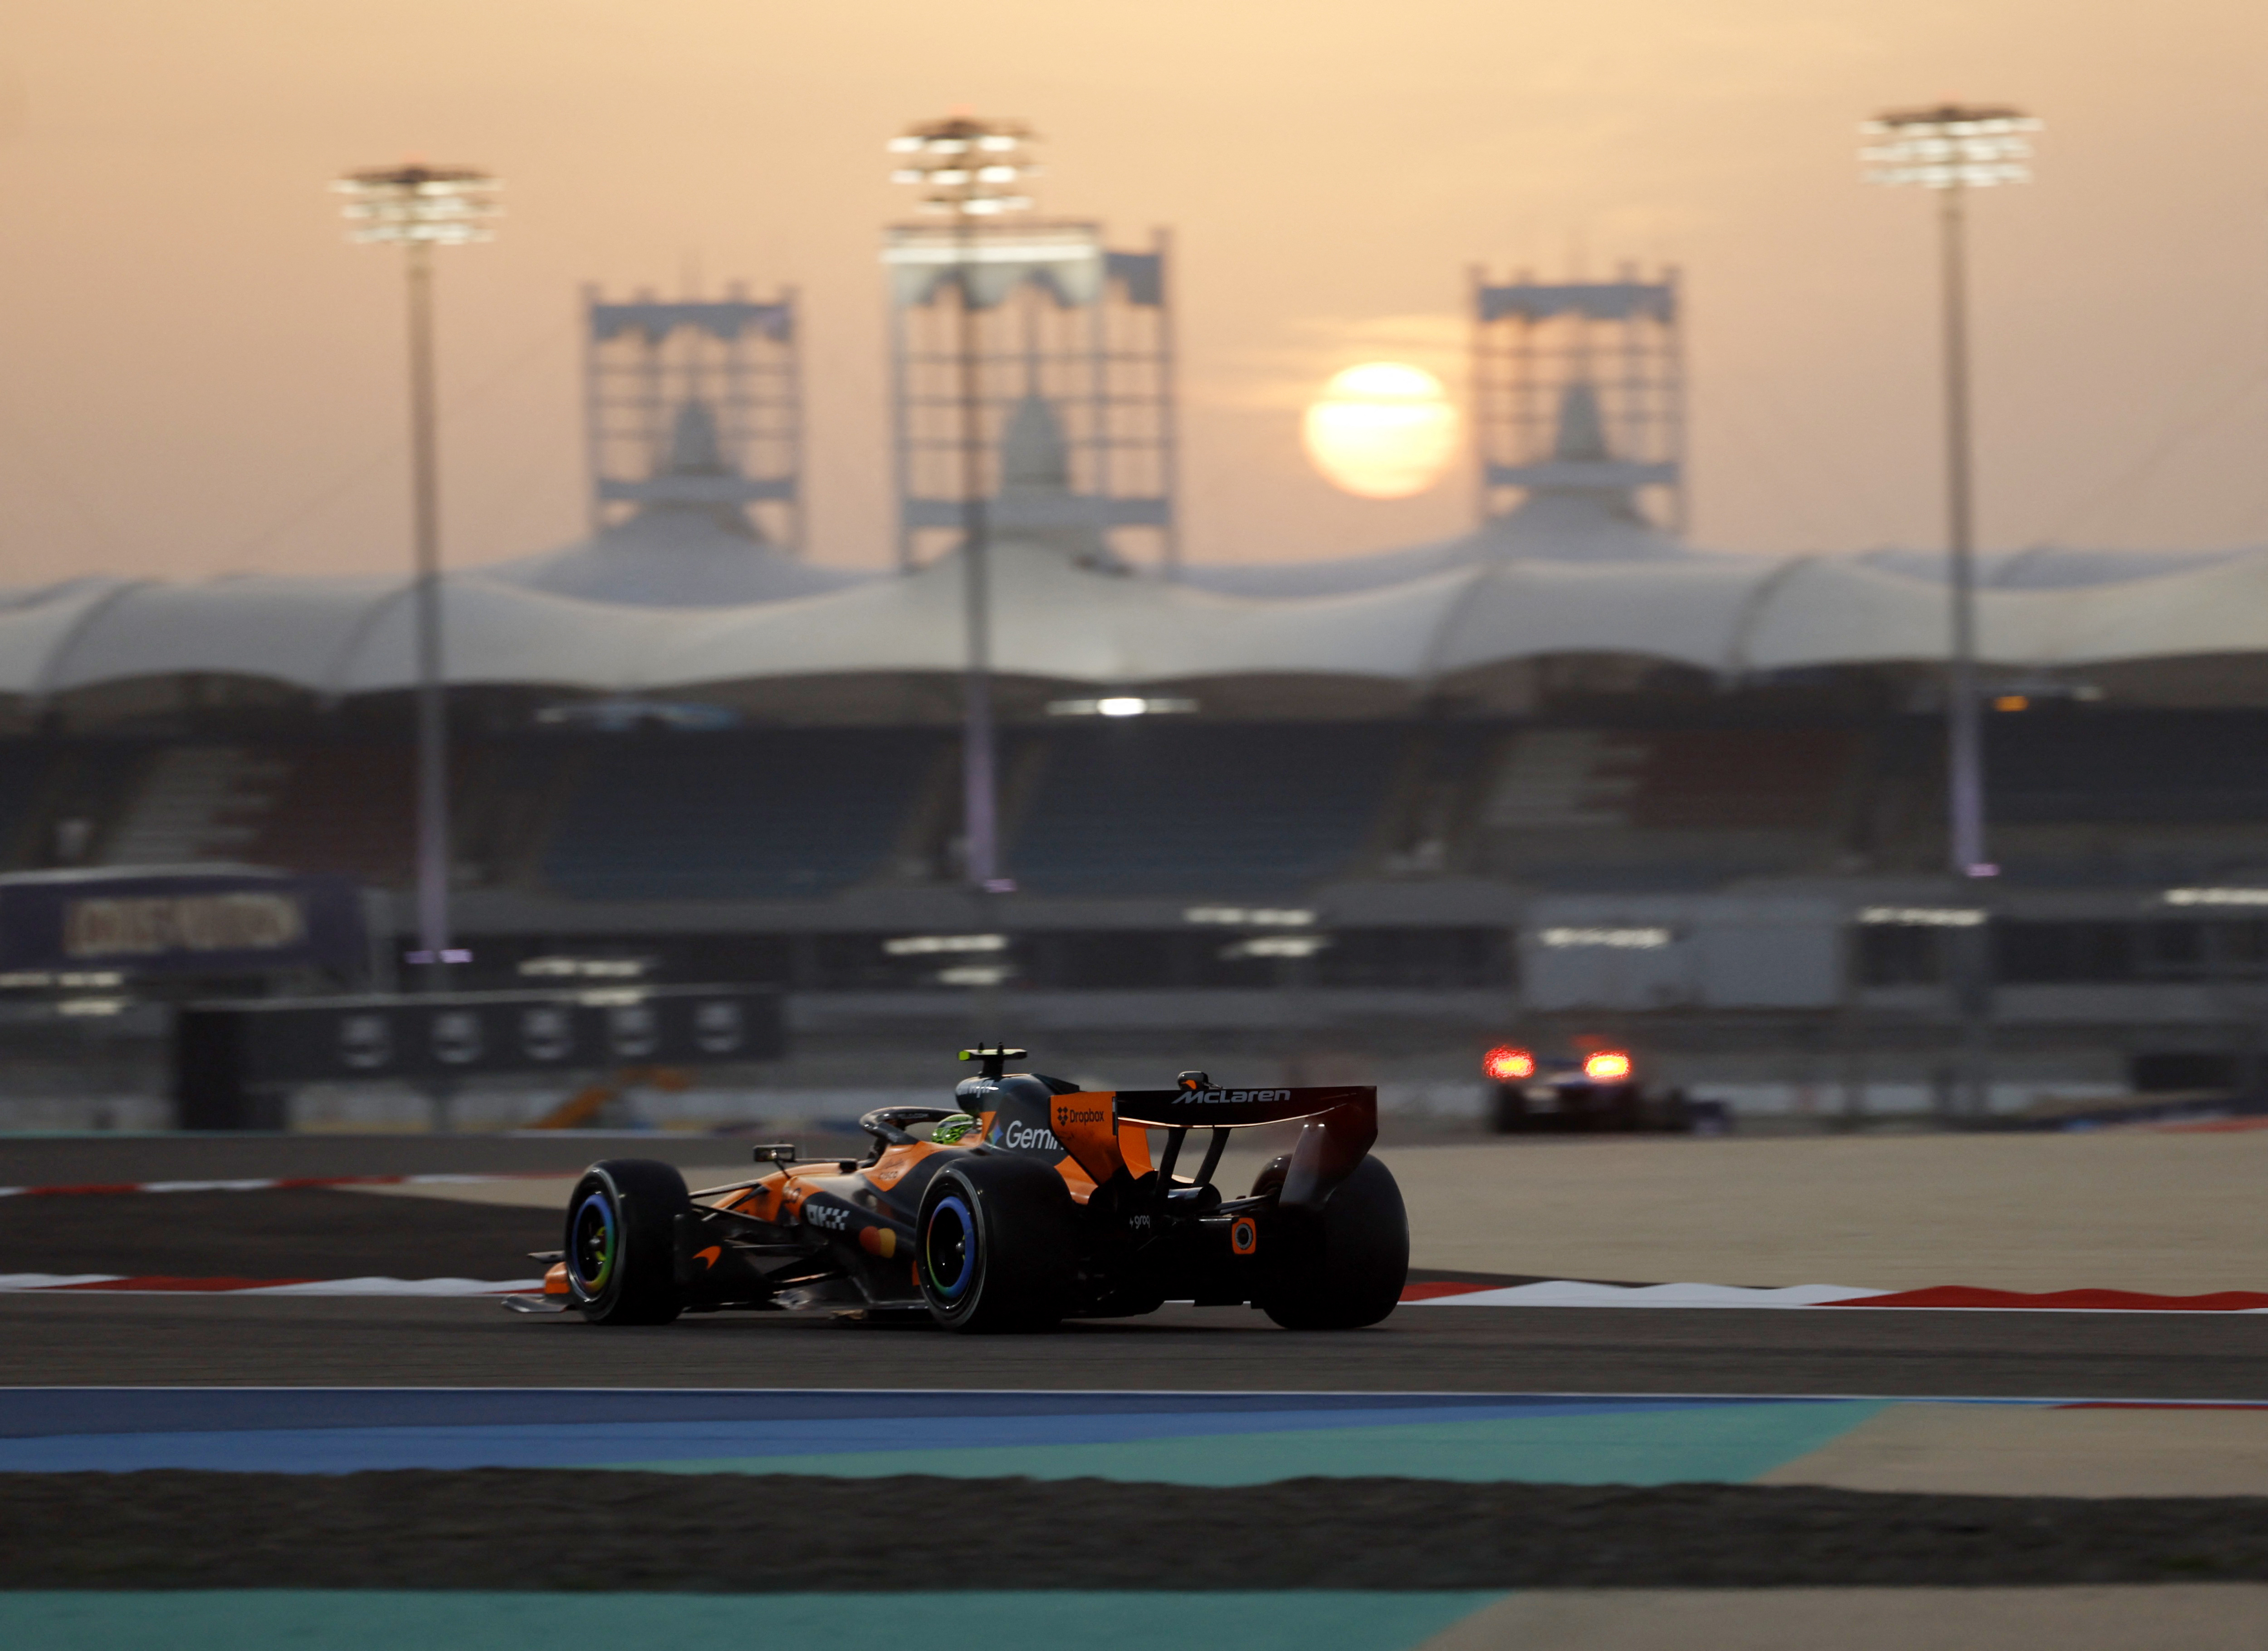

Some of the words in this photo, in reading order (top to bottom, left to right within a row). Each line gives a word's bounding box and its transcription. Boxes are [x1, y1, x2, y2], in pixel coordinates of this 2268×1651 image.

[1171, 1089, 1291, 1104] McLaren
[1070, 1108, 1105, 1126] Dropbox
[1134, 1215, 1150, 1229] groq
